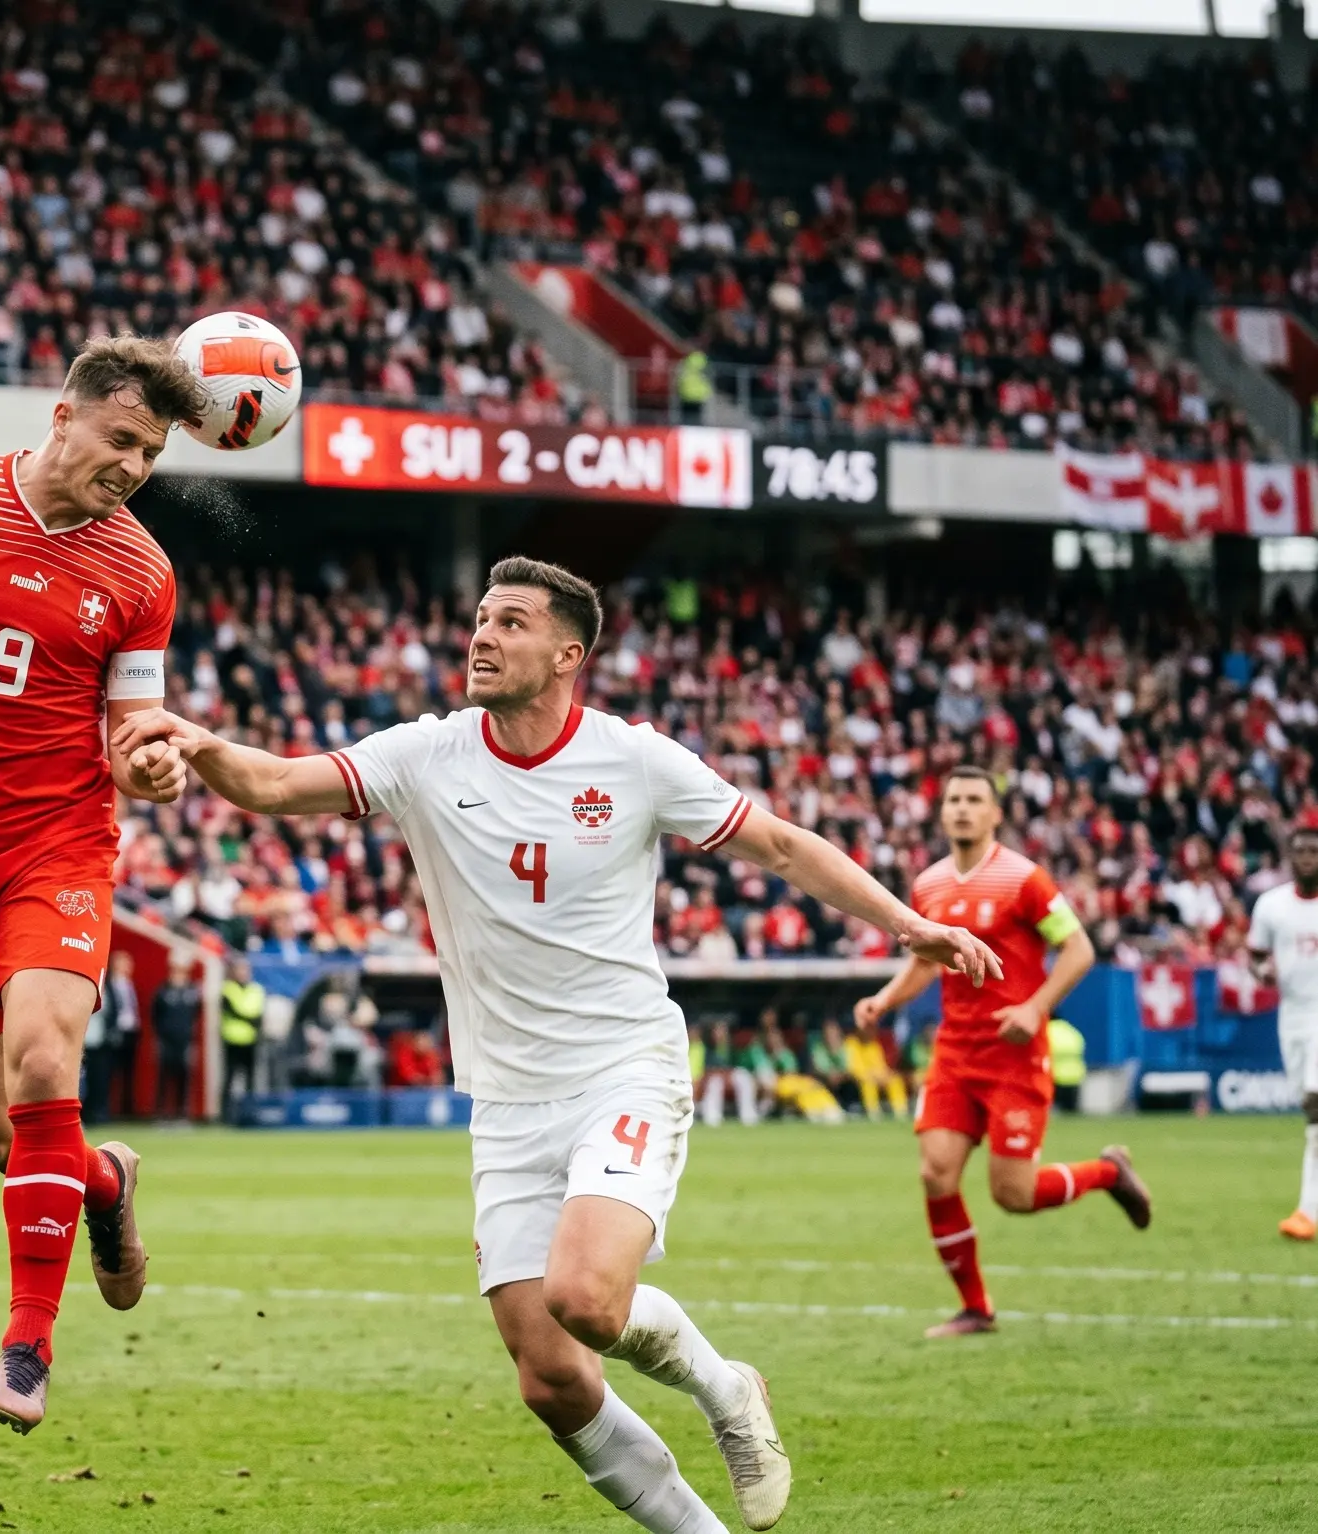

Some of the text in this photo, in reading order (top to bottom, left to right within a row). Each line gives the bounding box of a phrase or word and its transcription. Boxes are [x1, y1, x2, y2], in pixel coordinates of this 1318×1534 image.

[401, 423, 482, 482] SUI
[563, 433, 664, 492] CAN
[9, 573, 43, 593] PUMA
[509, 842, 549, 903] 4
[612, 1114, 650, 1167] 4
